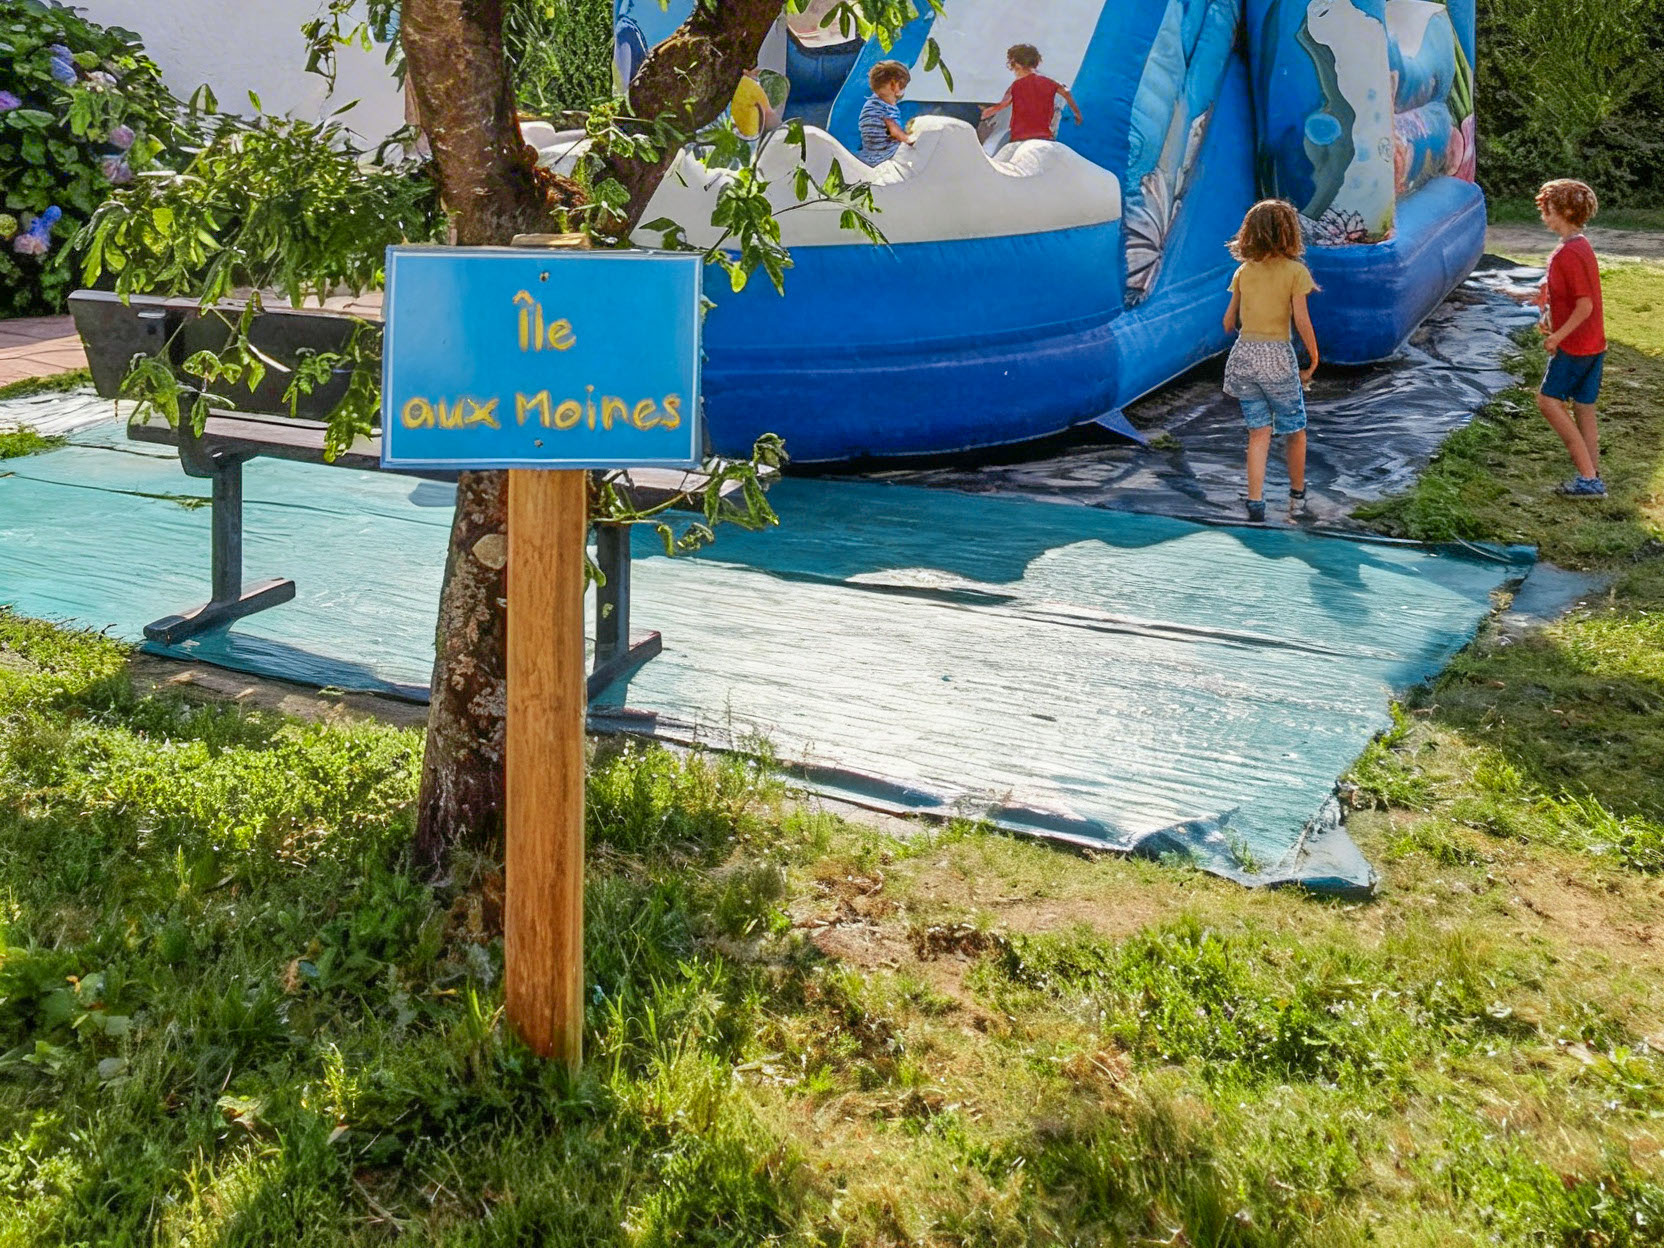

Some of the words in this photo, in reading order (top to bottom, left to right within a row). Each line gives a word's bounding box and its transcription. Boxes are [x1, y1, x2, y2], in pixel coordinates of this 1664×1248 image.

[513, 290, 576, 352] Île
[402, 397, 500, 429] aux
[515, 385, 681, 430] Moines
